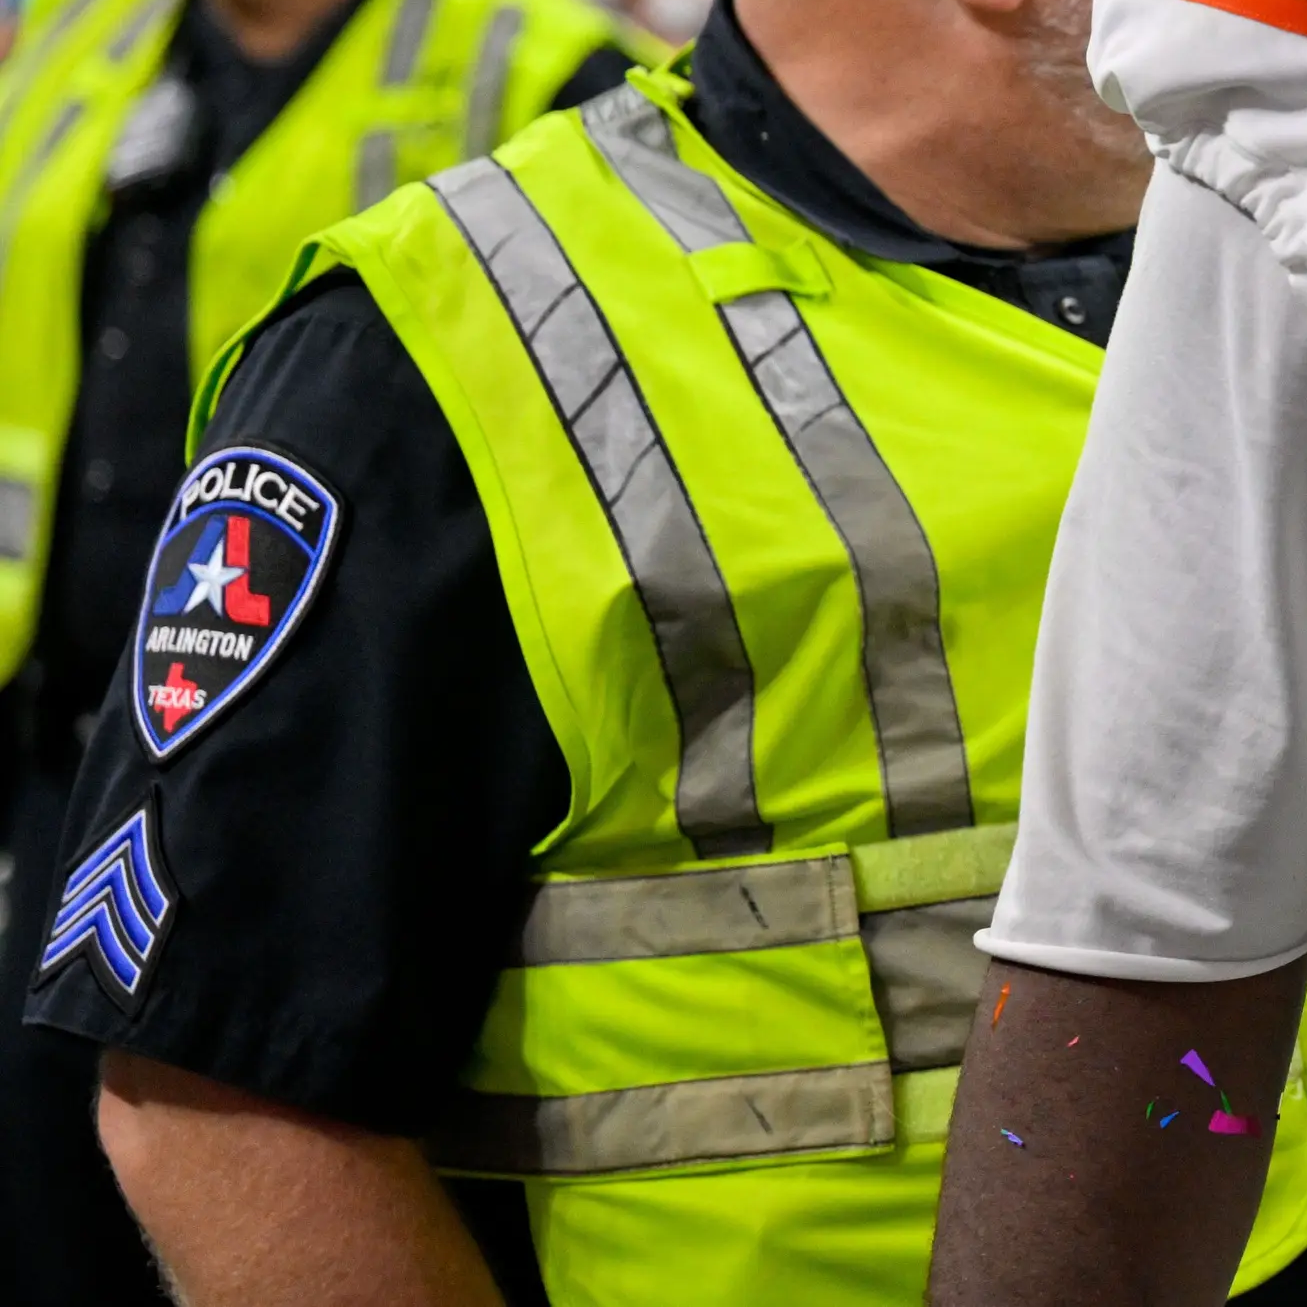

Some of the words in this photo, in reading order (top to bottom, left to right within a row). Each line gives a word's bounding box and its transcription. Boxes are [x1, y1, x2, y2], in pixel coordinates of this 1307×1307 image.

[178, 461, 321, 533] POLICE
[145, 625, 254, 662] ARLINGTON
[147, 684, 208, 711] TEXAS
